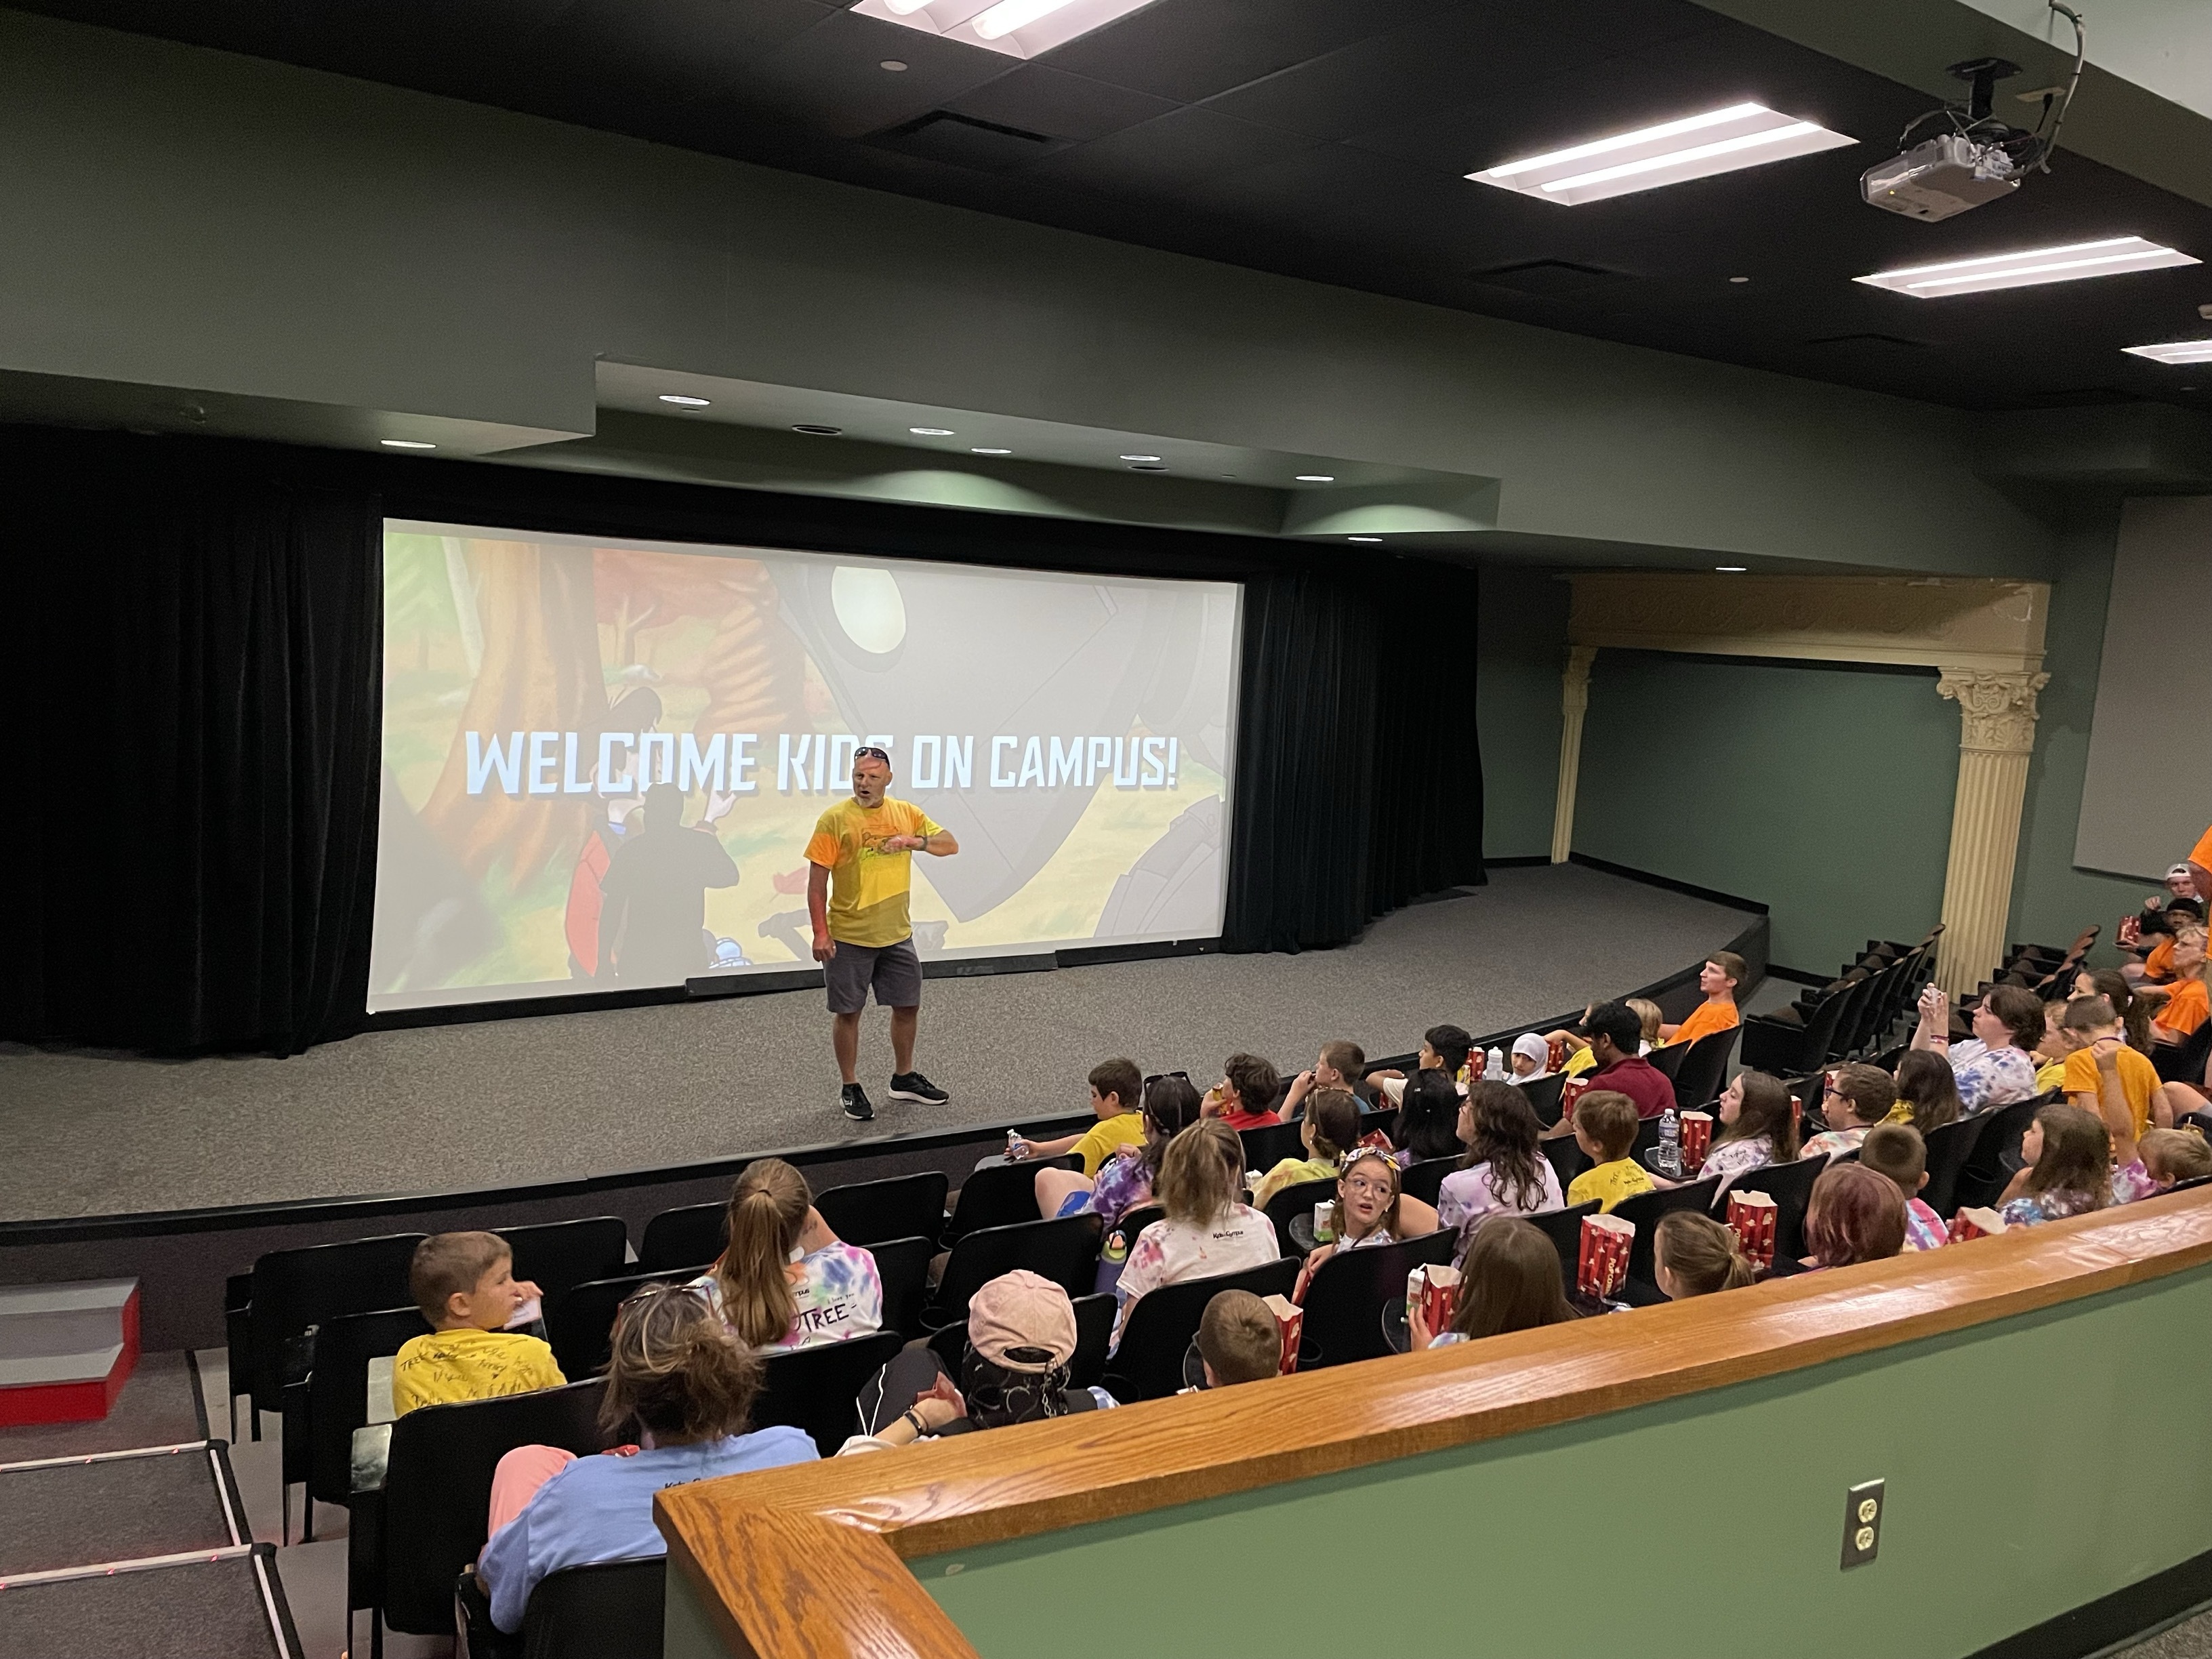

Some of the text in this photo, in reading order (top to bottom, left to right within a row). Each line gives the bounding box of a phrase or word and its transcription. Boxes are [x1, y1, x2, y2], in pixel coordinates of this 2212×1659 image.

[466, 731, 758, 794] WELCOME
[912, 735, 974, 788] ON
[990, 736, 1177, 787] CAMPUS!
[800, 1303, 849, 1332] TREE
